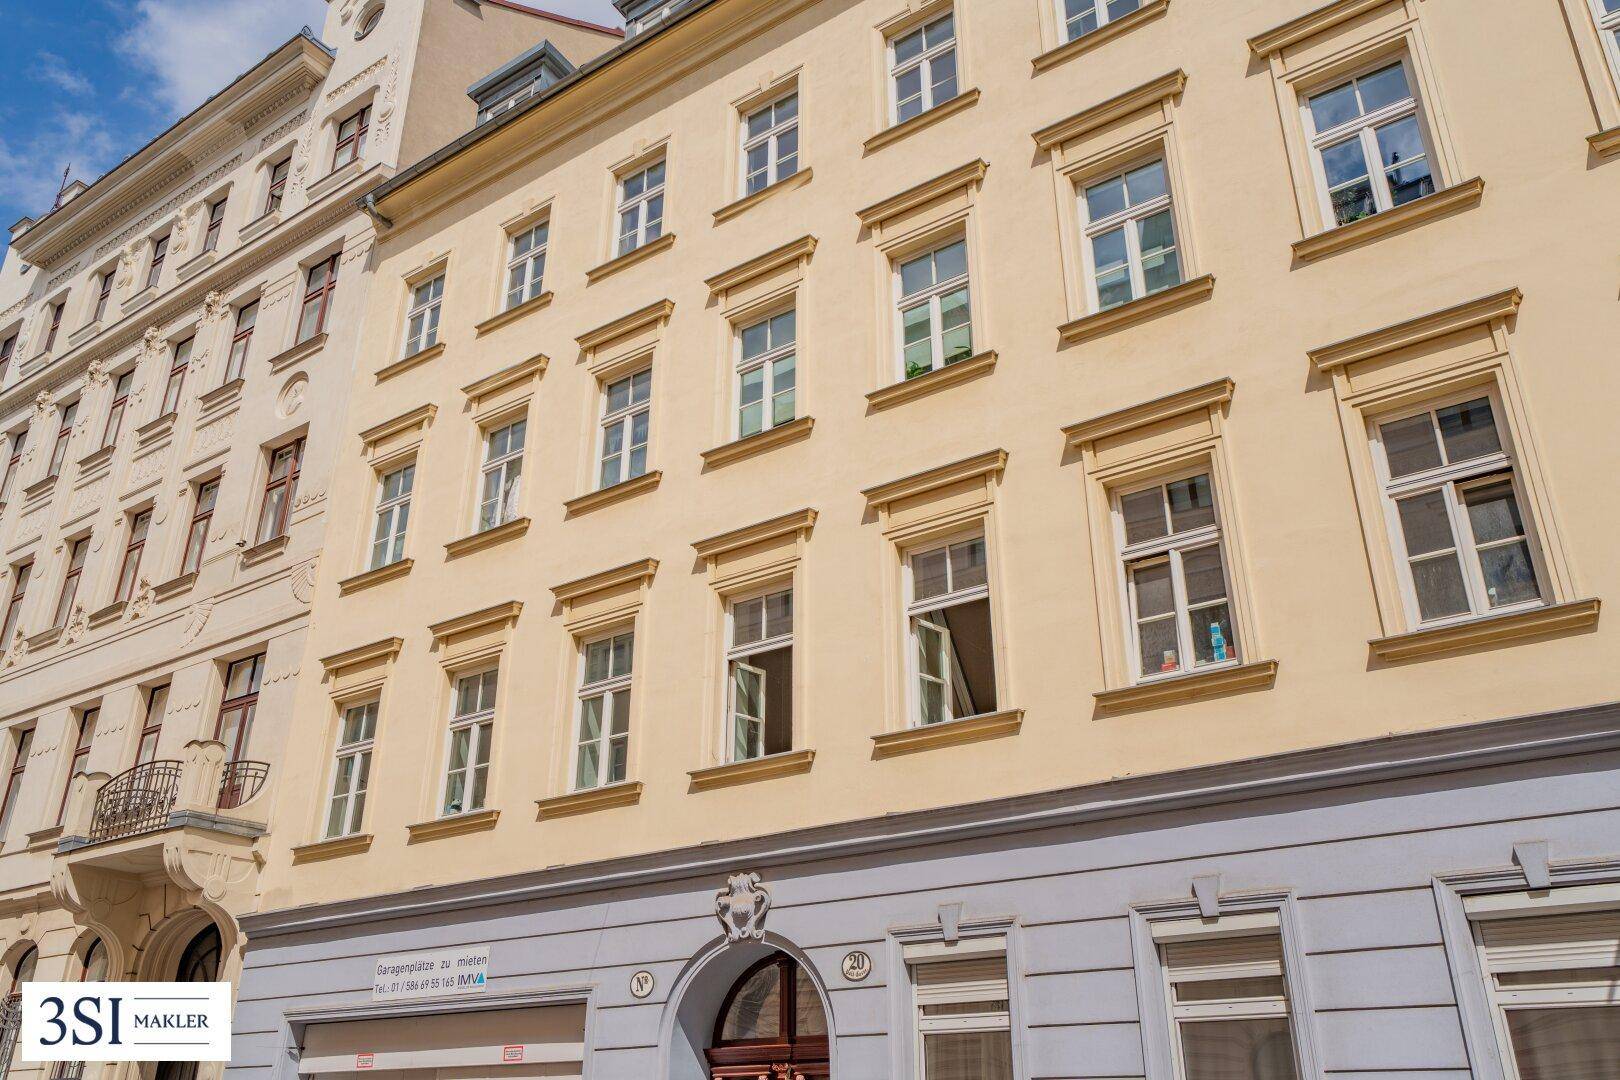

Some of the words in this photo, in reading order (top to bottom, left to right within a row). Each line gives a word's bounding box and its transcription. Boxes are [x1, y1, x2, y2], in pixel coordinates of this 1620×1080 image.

[376, 961, 435, 976] Garagenplätze
[440, 960, 451, 969] zu
[457, 955, 486, 968] mieten
[849, 953, 865, 970] 20
[375, 983, 390, 994] Tel.:
[391, 982, 399, 993] 01
[406, 980, 419, 991] 586
[420, 979, 430, 990] 69
[430, 979, 440, 989] 55
[442, 977, 455, 987] 165
